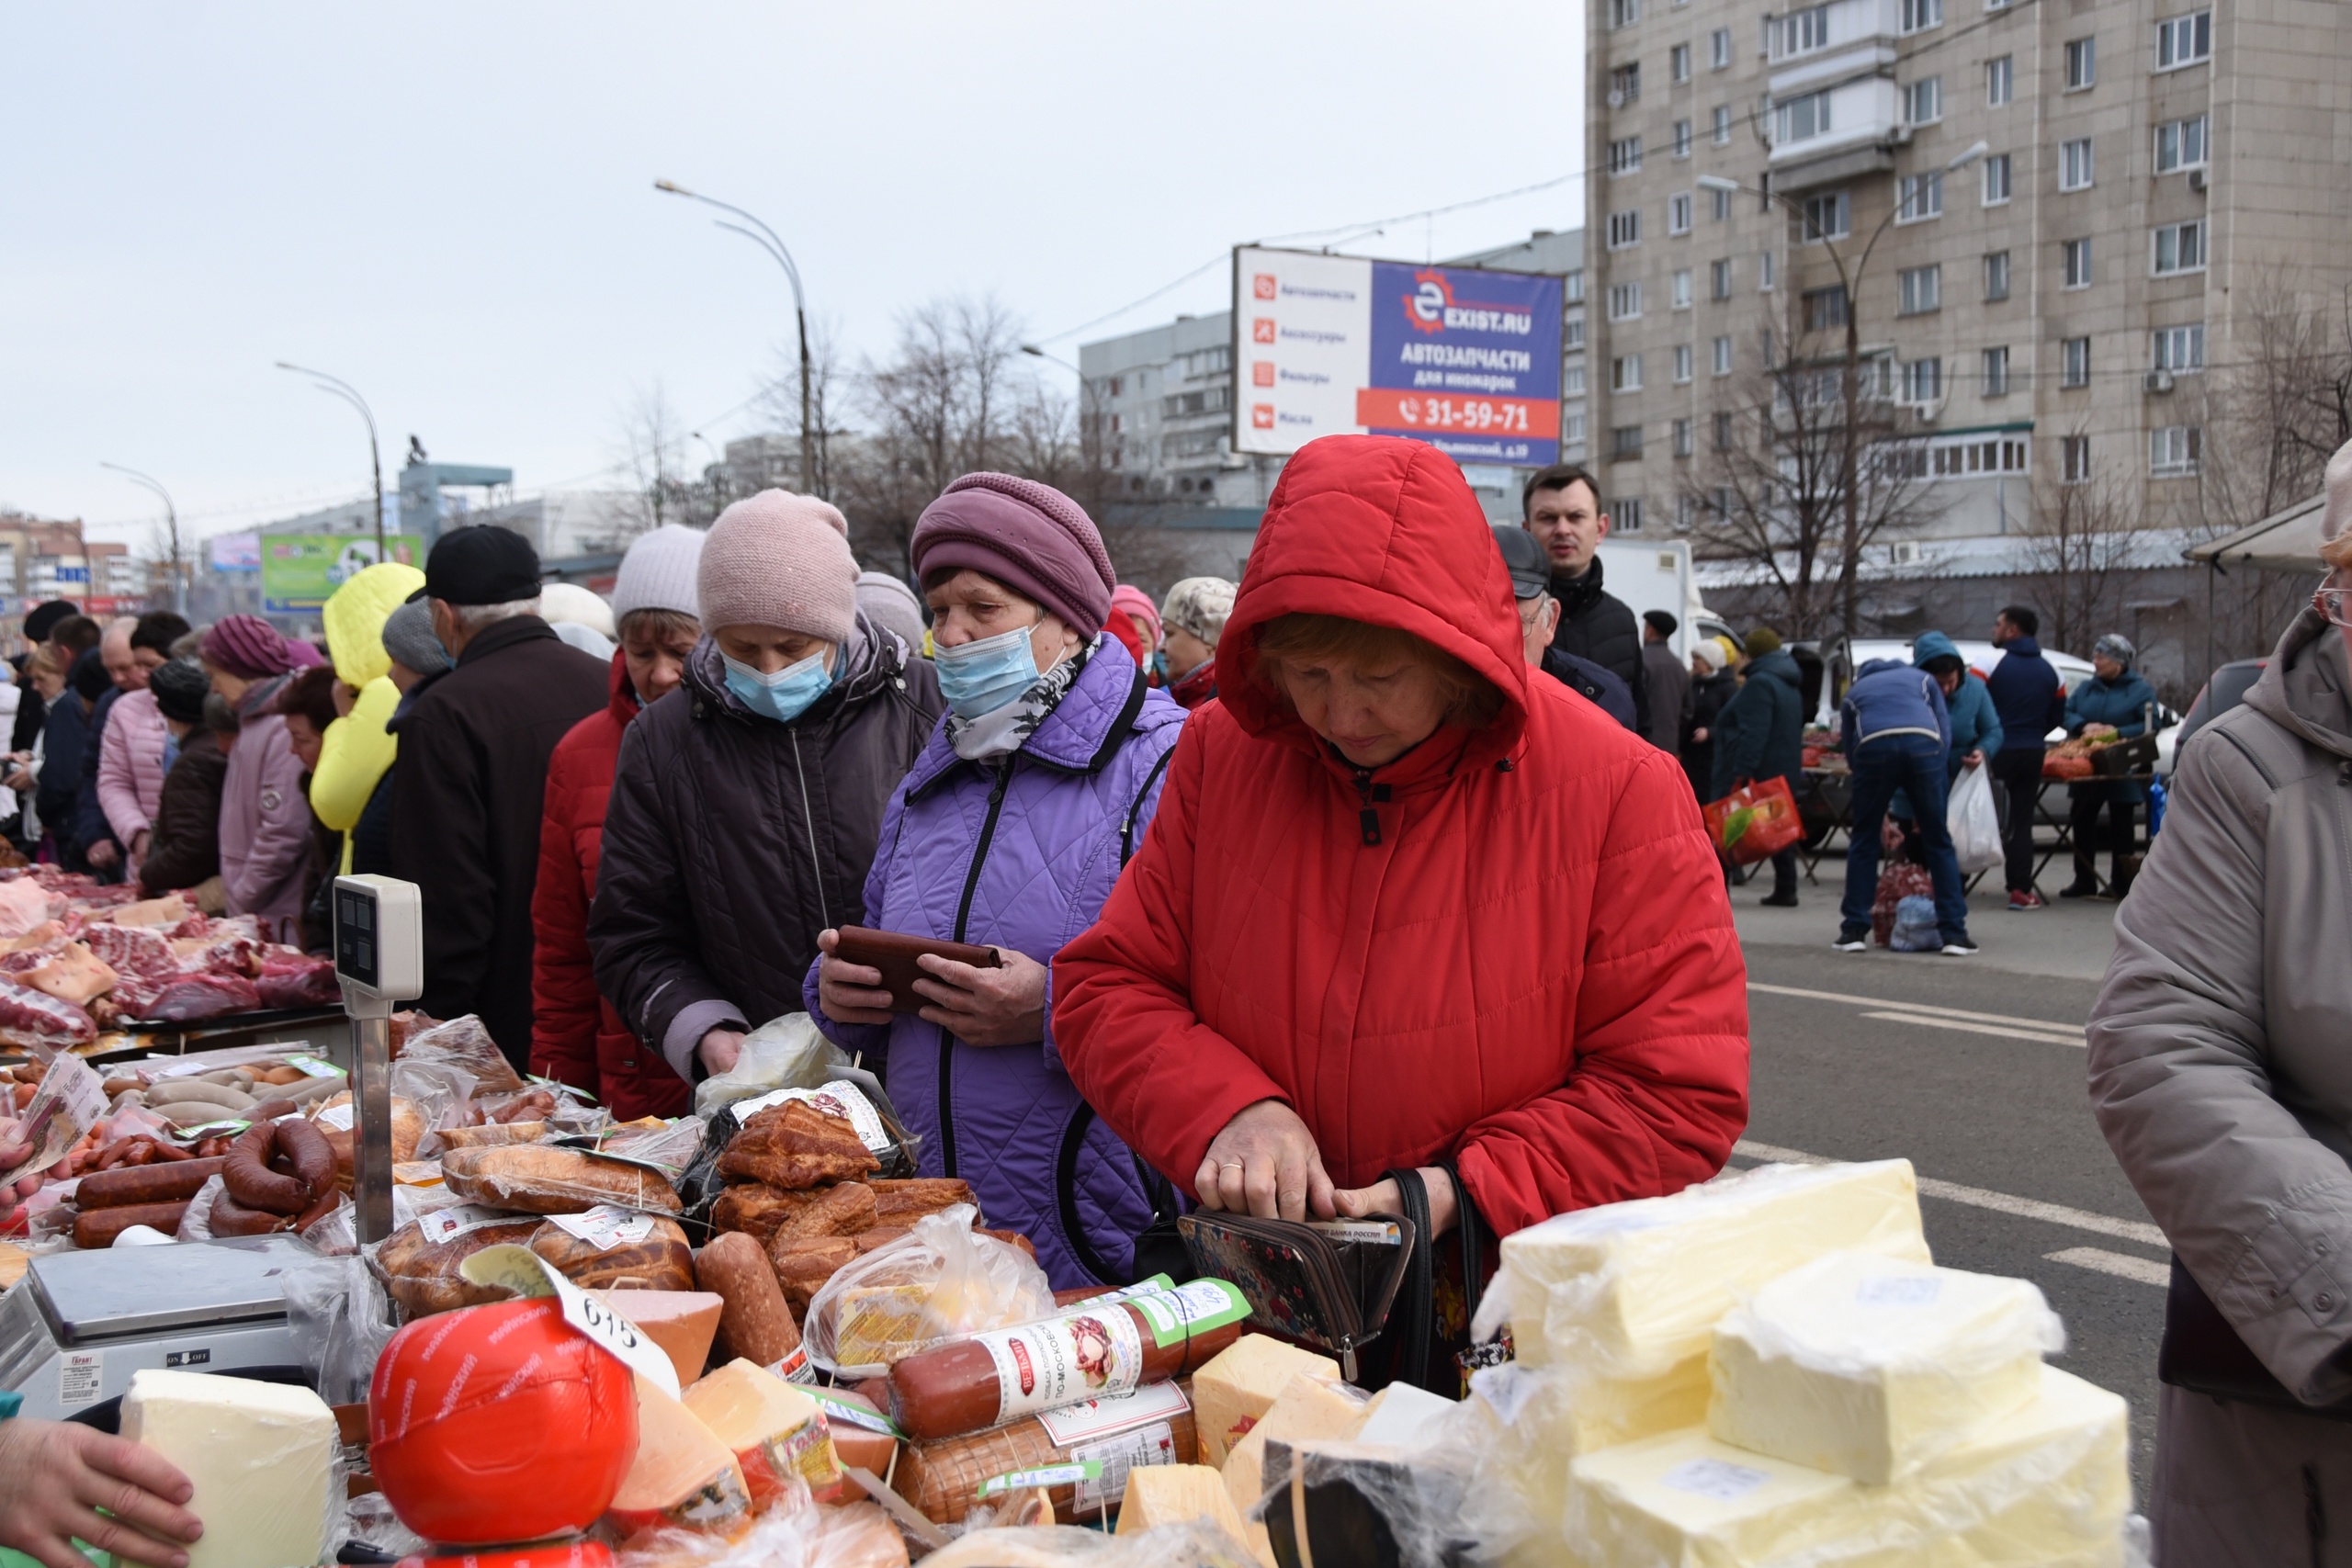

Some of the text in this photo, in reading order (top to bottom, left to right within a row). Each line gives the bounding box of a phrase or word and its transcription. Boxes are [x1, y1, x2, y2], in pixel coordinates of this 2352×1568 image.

[1444, 307, 1532, 335] EXIST.RU
[1401, 343, 1531, 372] АВТОЗАПЧАСТИ
[1414, 370, 1517, 393] для иномарок
[1425, 398, 1528, 431] 31-59-71
[1352, 1231, 1381, 1239] РОССИИ
[488, 1304, 551, 1346] МАЙНСКИЙ
[167, 1355, 179, 1364] ON
[192, 1352, 208, 1361] OFF
[1012, 1340, 1033, 1388] ВЕЛЬМИ
[1159, 1438, 1170, 1466] Вель
